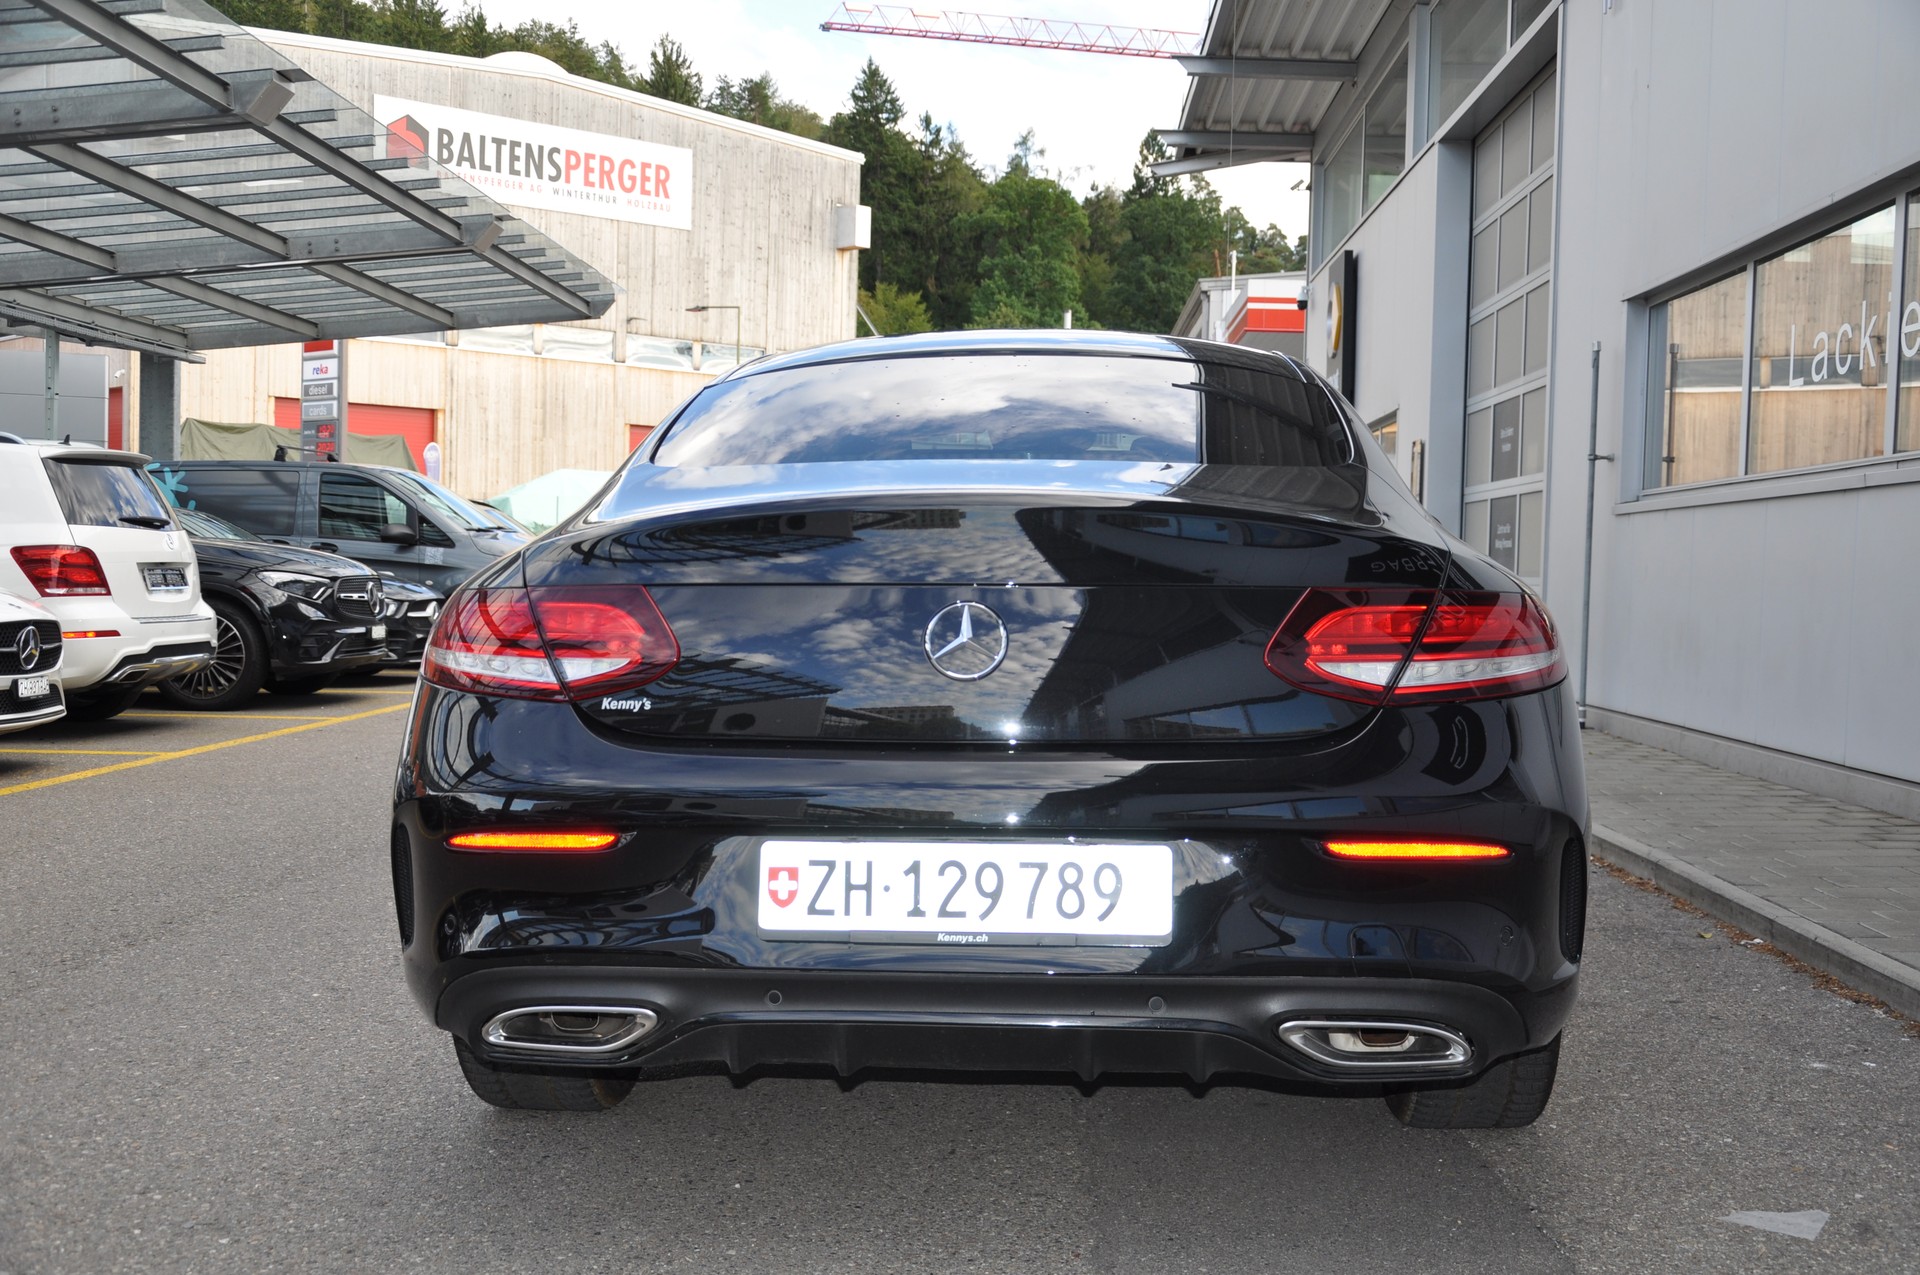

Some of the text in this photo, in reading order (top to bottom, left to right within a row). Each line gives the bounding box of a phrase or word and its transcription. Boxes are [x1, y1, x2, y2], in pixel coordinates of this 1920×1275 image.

[437, 127, 671, 200] BALTENSPERGER
[436, 170, 671, 213] BATENSPERGER AG WINTERTHUR HOLZBAU
[312, 363, 329, 376] reka
[308, 384, 328, 396] diesel
[308, 405, 327, 416] cards
[601, 697, 652, 713] Kenny's
[937, 932, 989, 944] Kennys.ch
